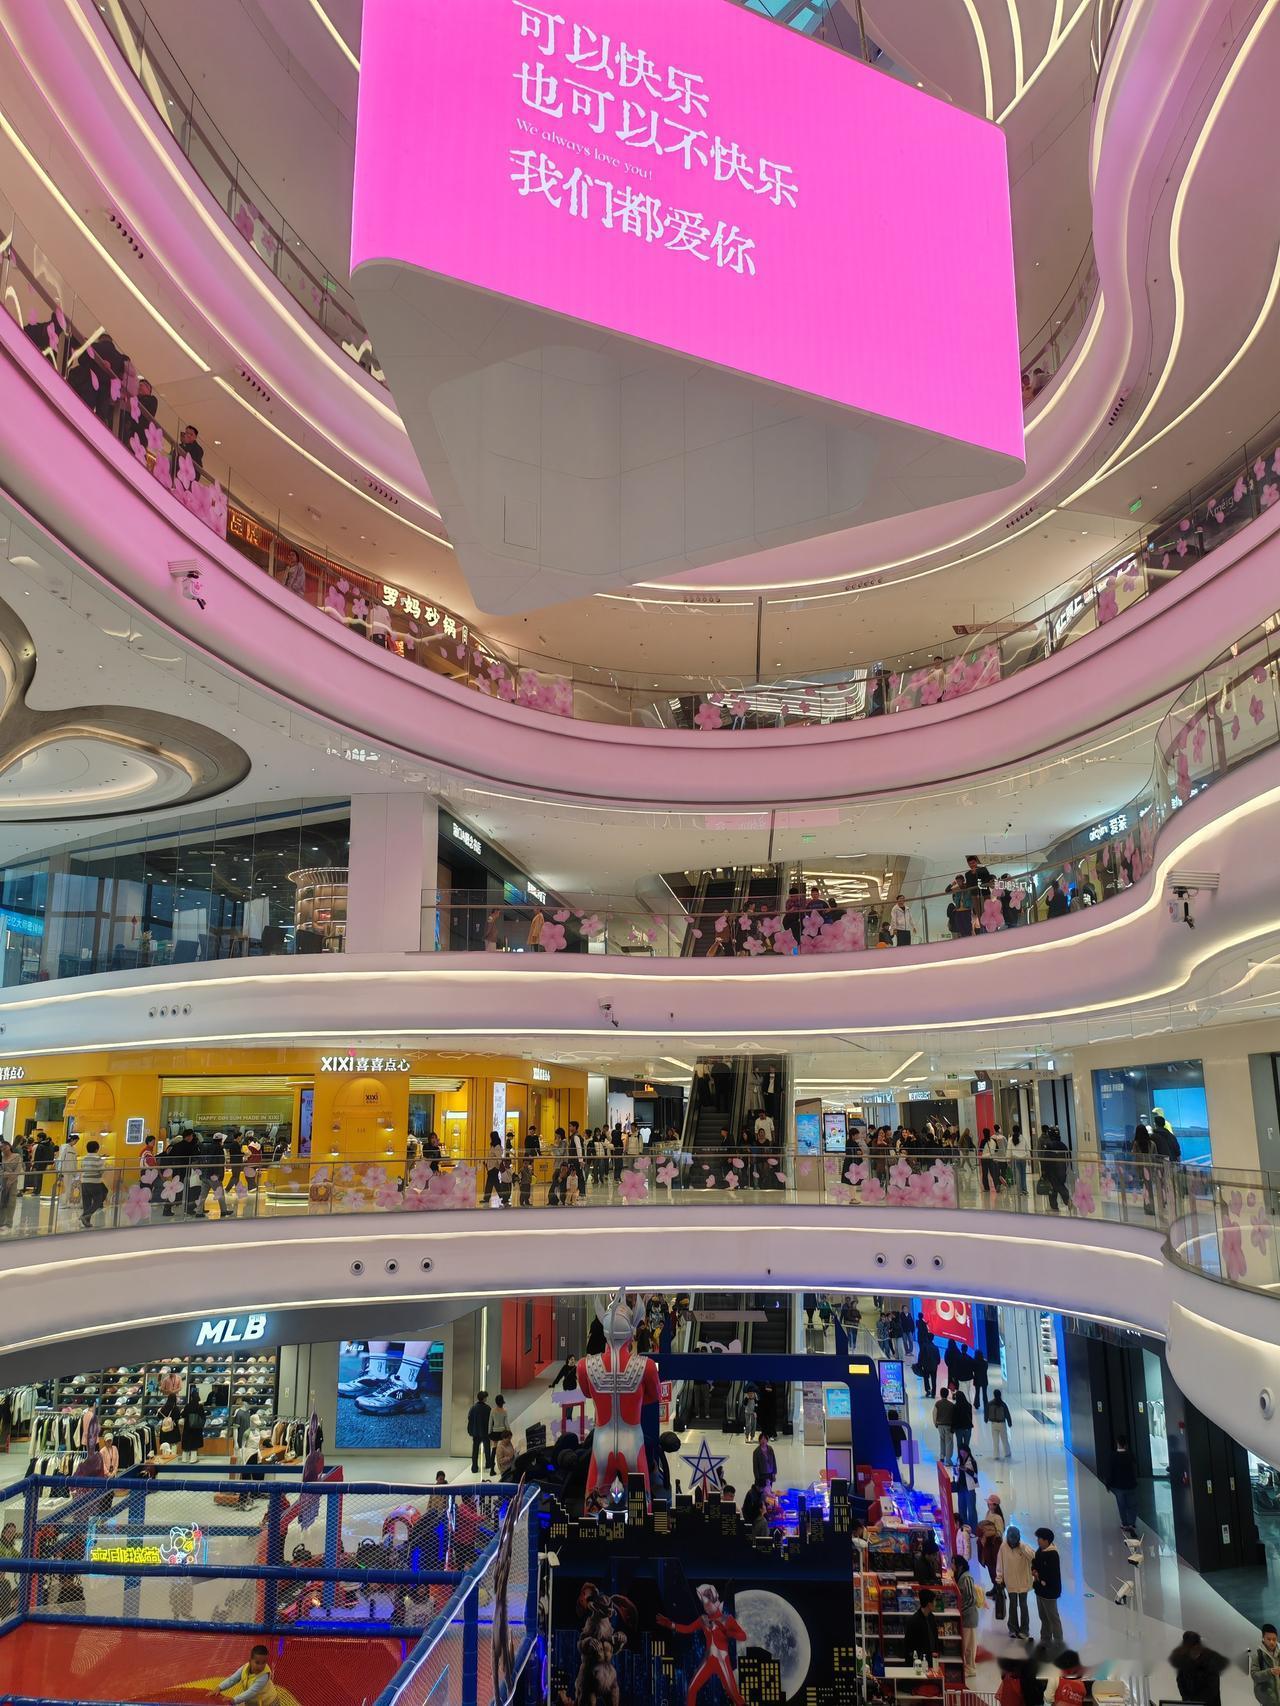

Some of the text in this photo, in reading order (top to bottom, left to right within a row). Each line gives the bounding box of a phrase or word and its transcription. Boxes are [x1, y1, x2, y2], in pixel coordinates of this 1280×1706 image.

[512, 0, 710, 118] 可以快乐
[512, 62, 799, 208] 也可以不快乐
[516, 117, 653, 181] We always love you!
[509, 149, 756, 276] 我们都爱你
[321, 1056, 410, 1072] XIXI 喜喜点心
[195, 1312, 267, 1347] MLB
